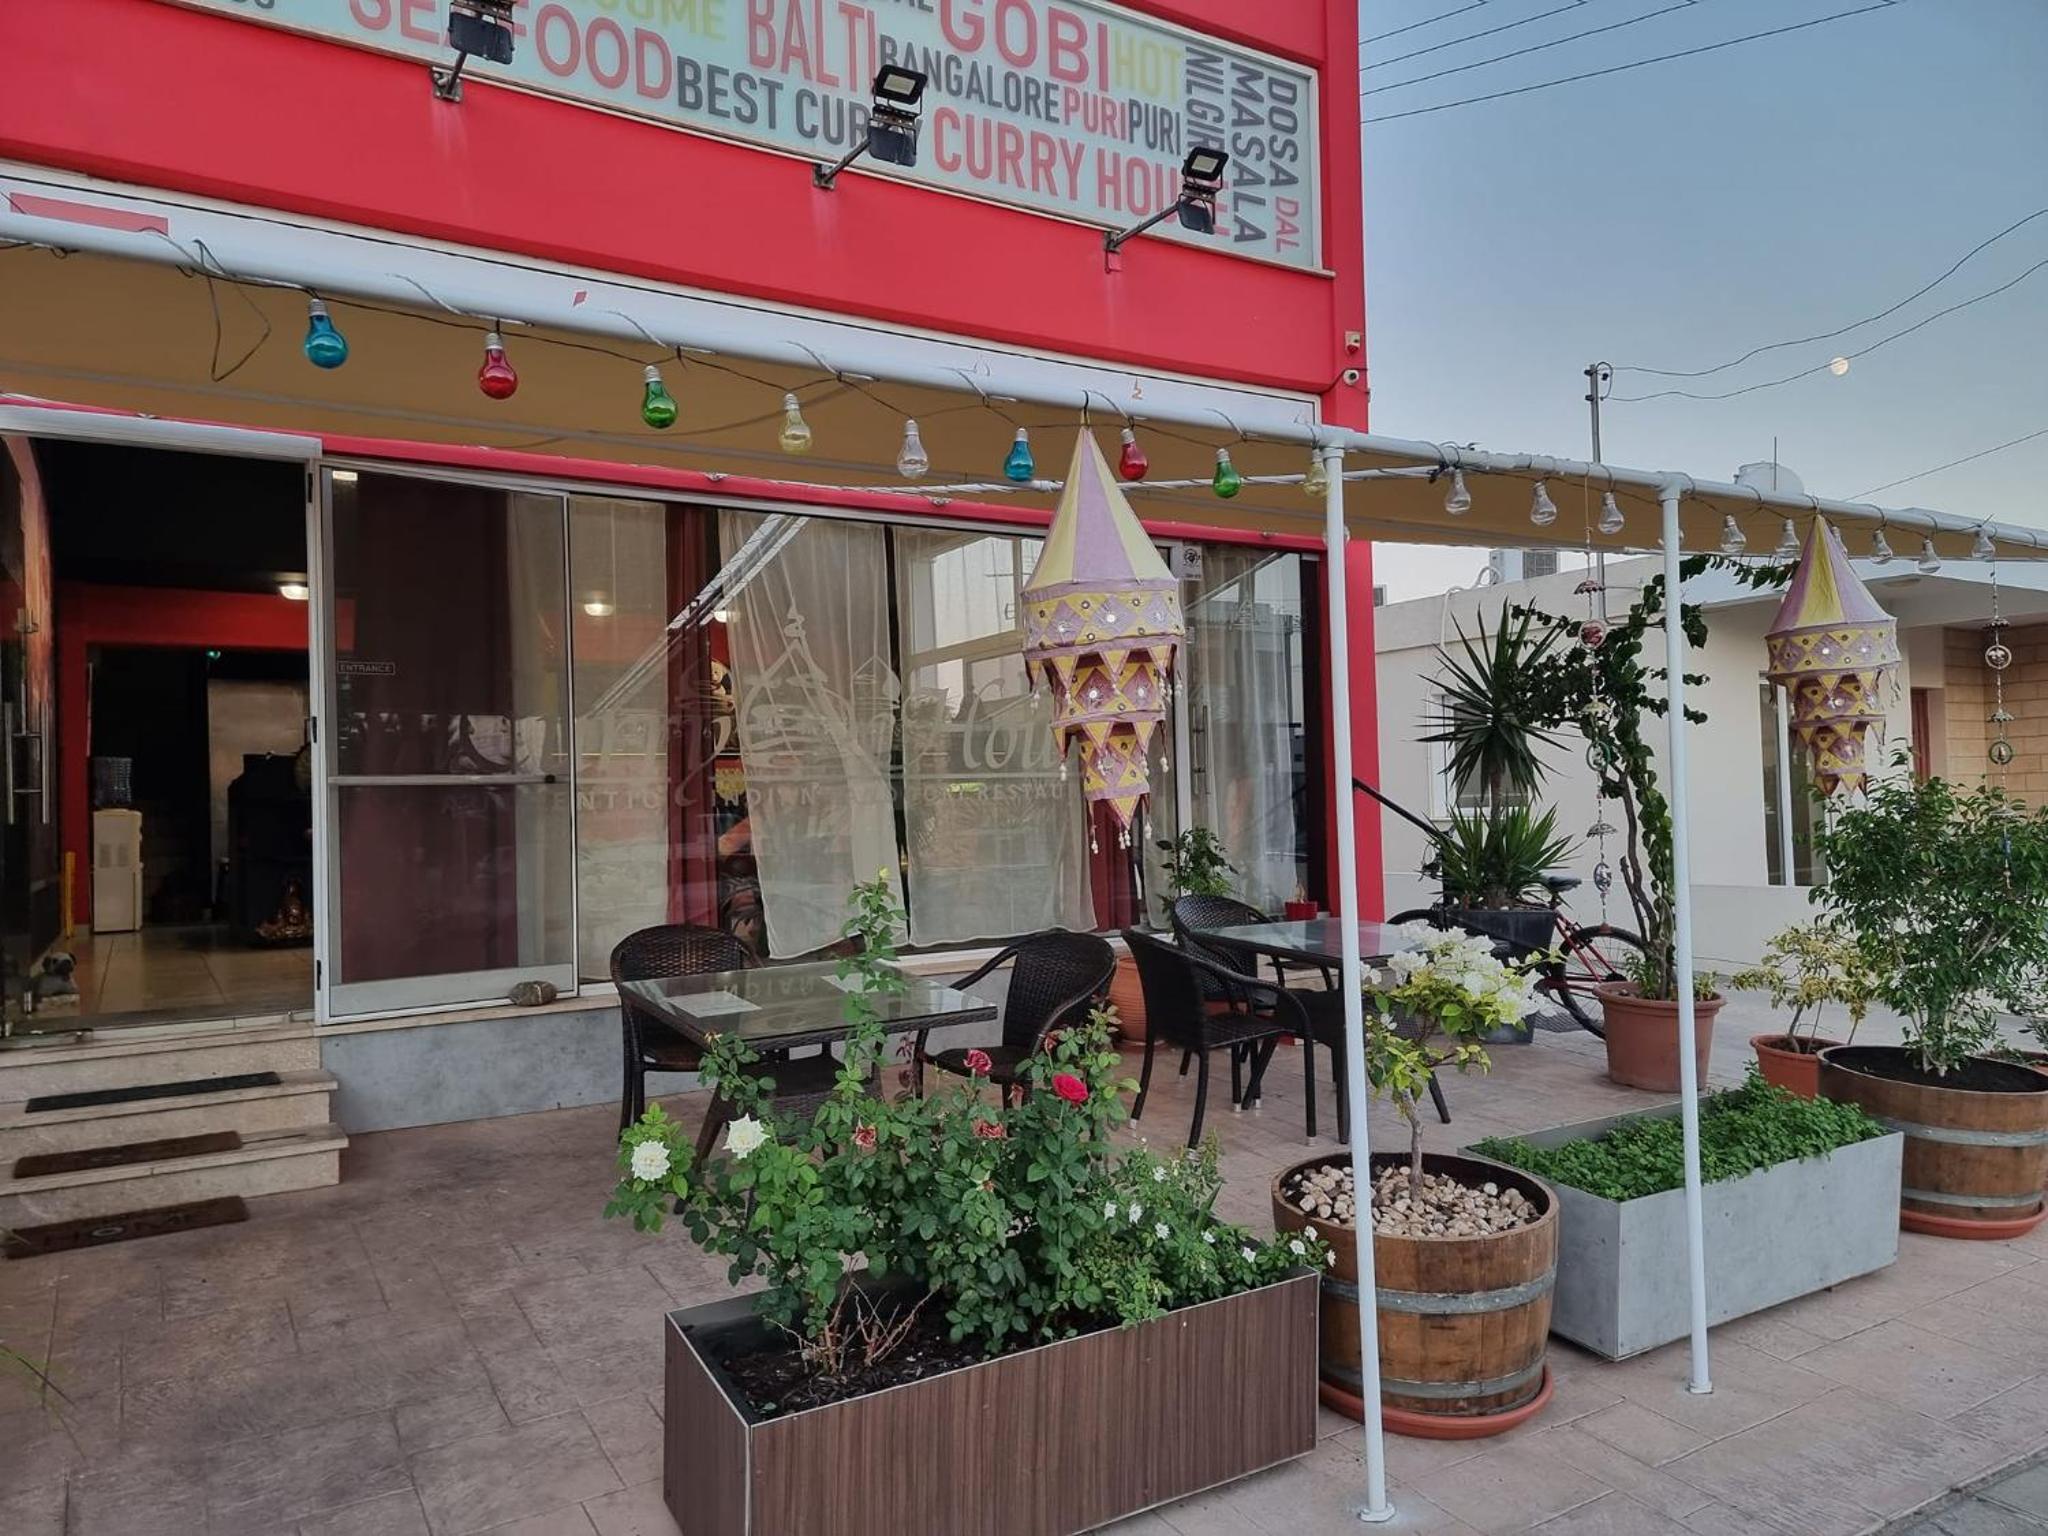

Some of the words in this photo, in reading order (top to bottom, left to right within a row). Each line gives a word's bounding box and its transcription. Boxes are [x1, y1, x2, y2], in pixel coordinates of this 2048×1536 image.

[746, 0, 877, 97] BALTI
[879, 33, 1061, 125] BANGALORE
[939, 0, 1110, 92] GOBI
[1114, 28, 1181, 101] HOT
[676, 55, 784, 130] BEST
[795, 88, 923, 152] CUR
[1062, 86, 1127, 142] PURI
[1127, 98, 1182, 156] PURI
[1185, 46, 1226, 153] NILGIR
[1267, 76, 1300, 188] DOSA
[933, 106, 1086, 201] CURRY
[1230, 62, 1267, 243] MASALA
[1275, 196, 1300, 253] DAL
[340, 663, 392, 673] ENTRANCE
